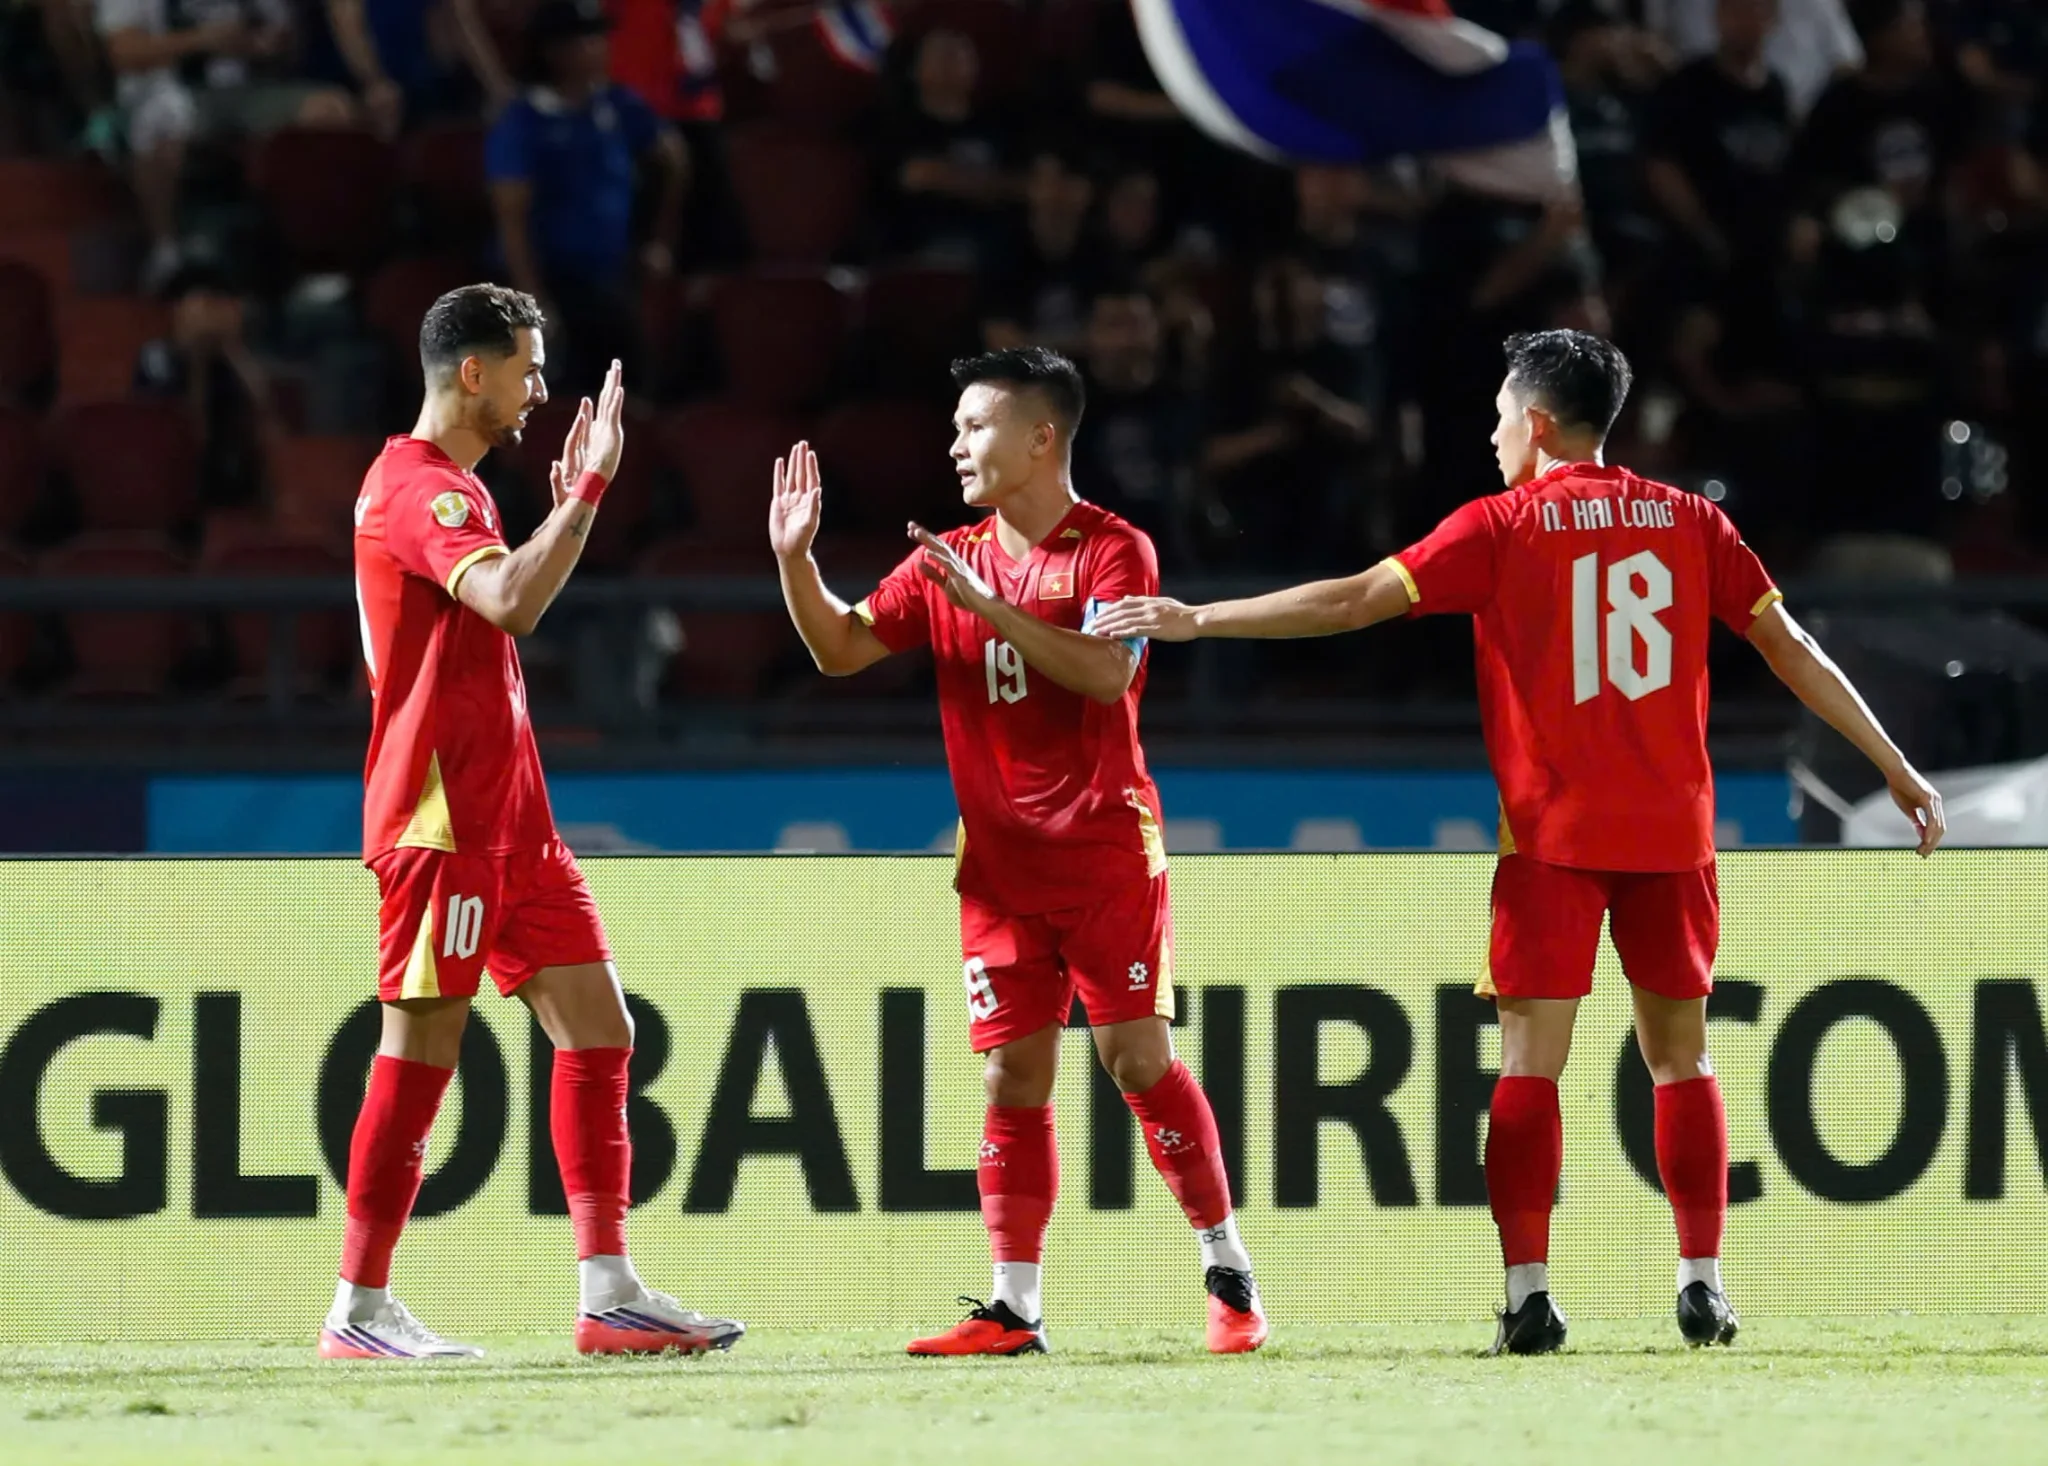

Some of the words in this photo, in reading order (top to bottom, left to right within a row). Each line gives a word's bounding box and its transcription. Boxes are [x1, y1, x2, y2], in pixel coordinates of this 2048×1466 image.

[1572, 497, 1613, 530] HAI
[1618, 496, 1676, 528] LONG
[1572, 549, 1673, 705] 18
[985, 638, 1027, 704] 19
[443, 893, 484, 960] 10
[964, 956, 999, 1024] 9
[0, 985, 983, 1220] GLOBAL
